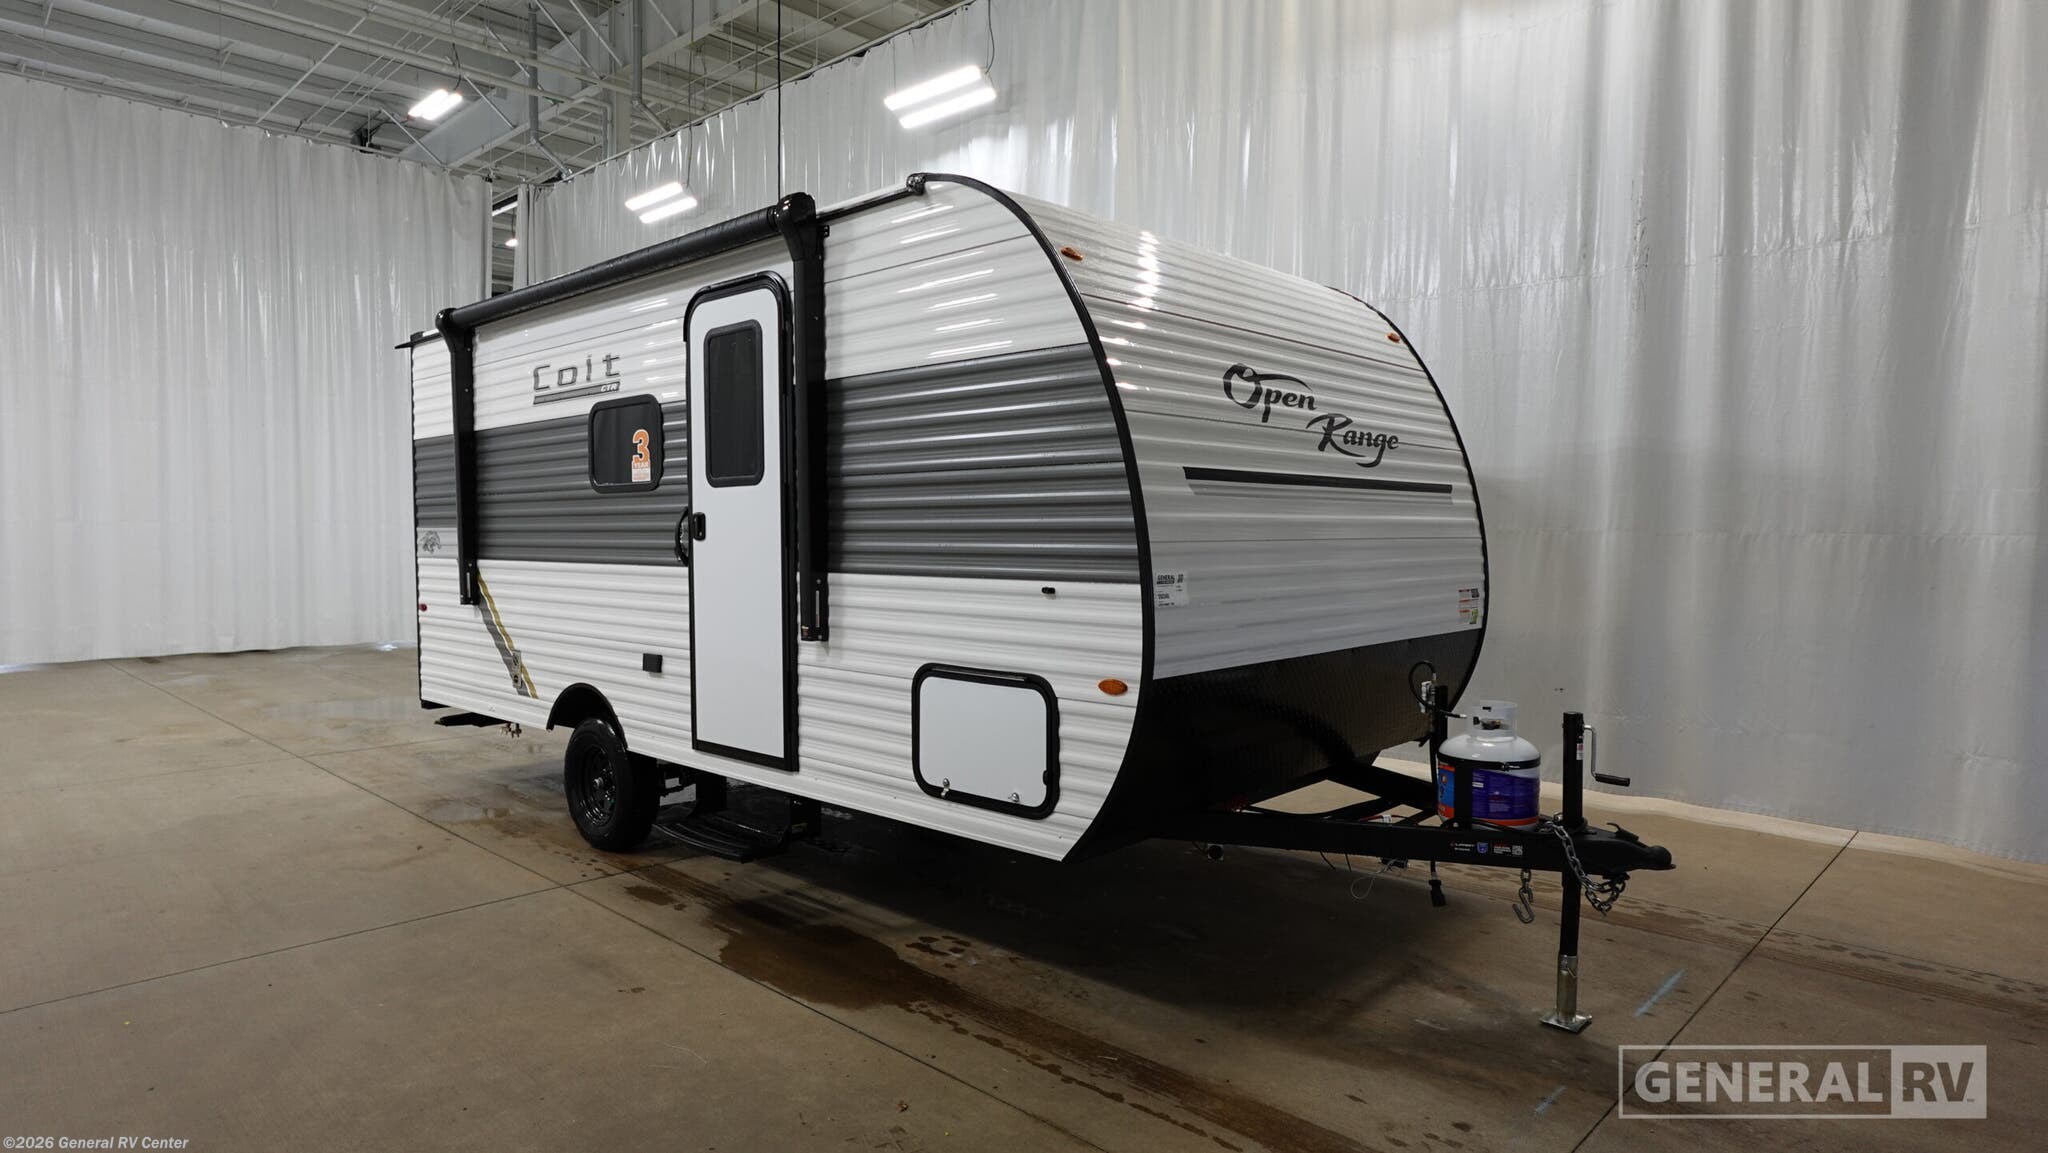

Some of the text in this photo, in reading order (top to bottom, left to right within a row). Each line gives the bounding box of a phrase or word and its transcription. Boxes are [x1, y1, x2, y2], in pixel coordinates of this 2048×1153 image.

[1223, 362, 1317, 423] Open
[632, 429, 650, 463] 3
[1305, 413, 1399, 468] Range
